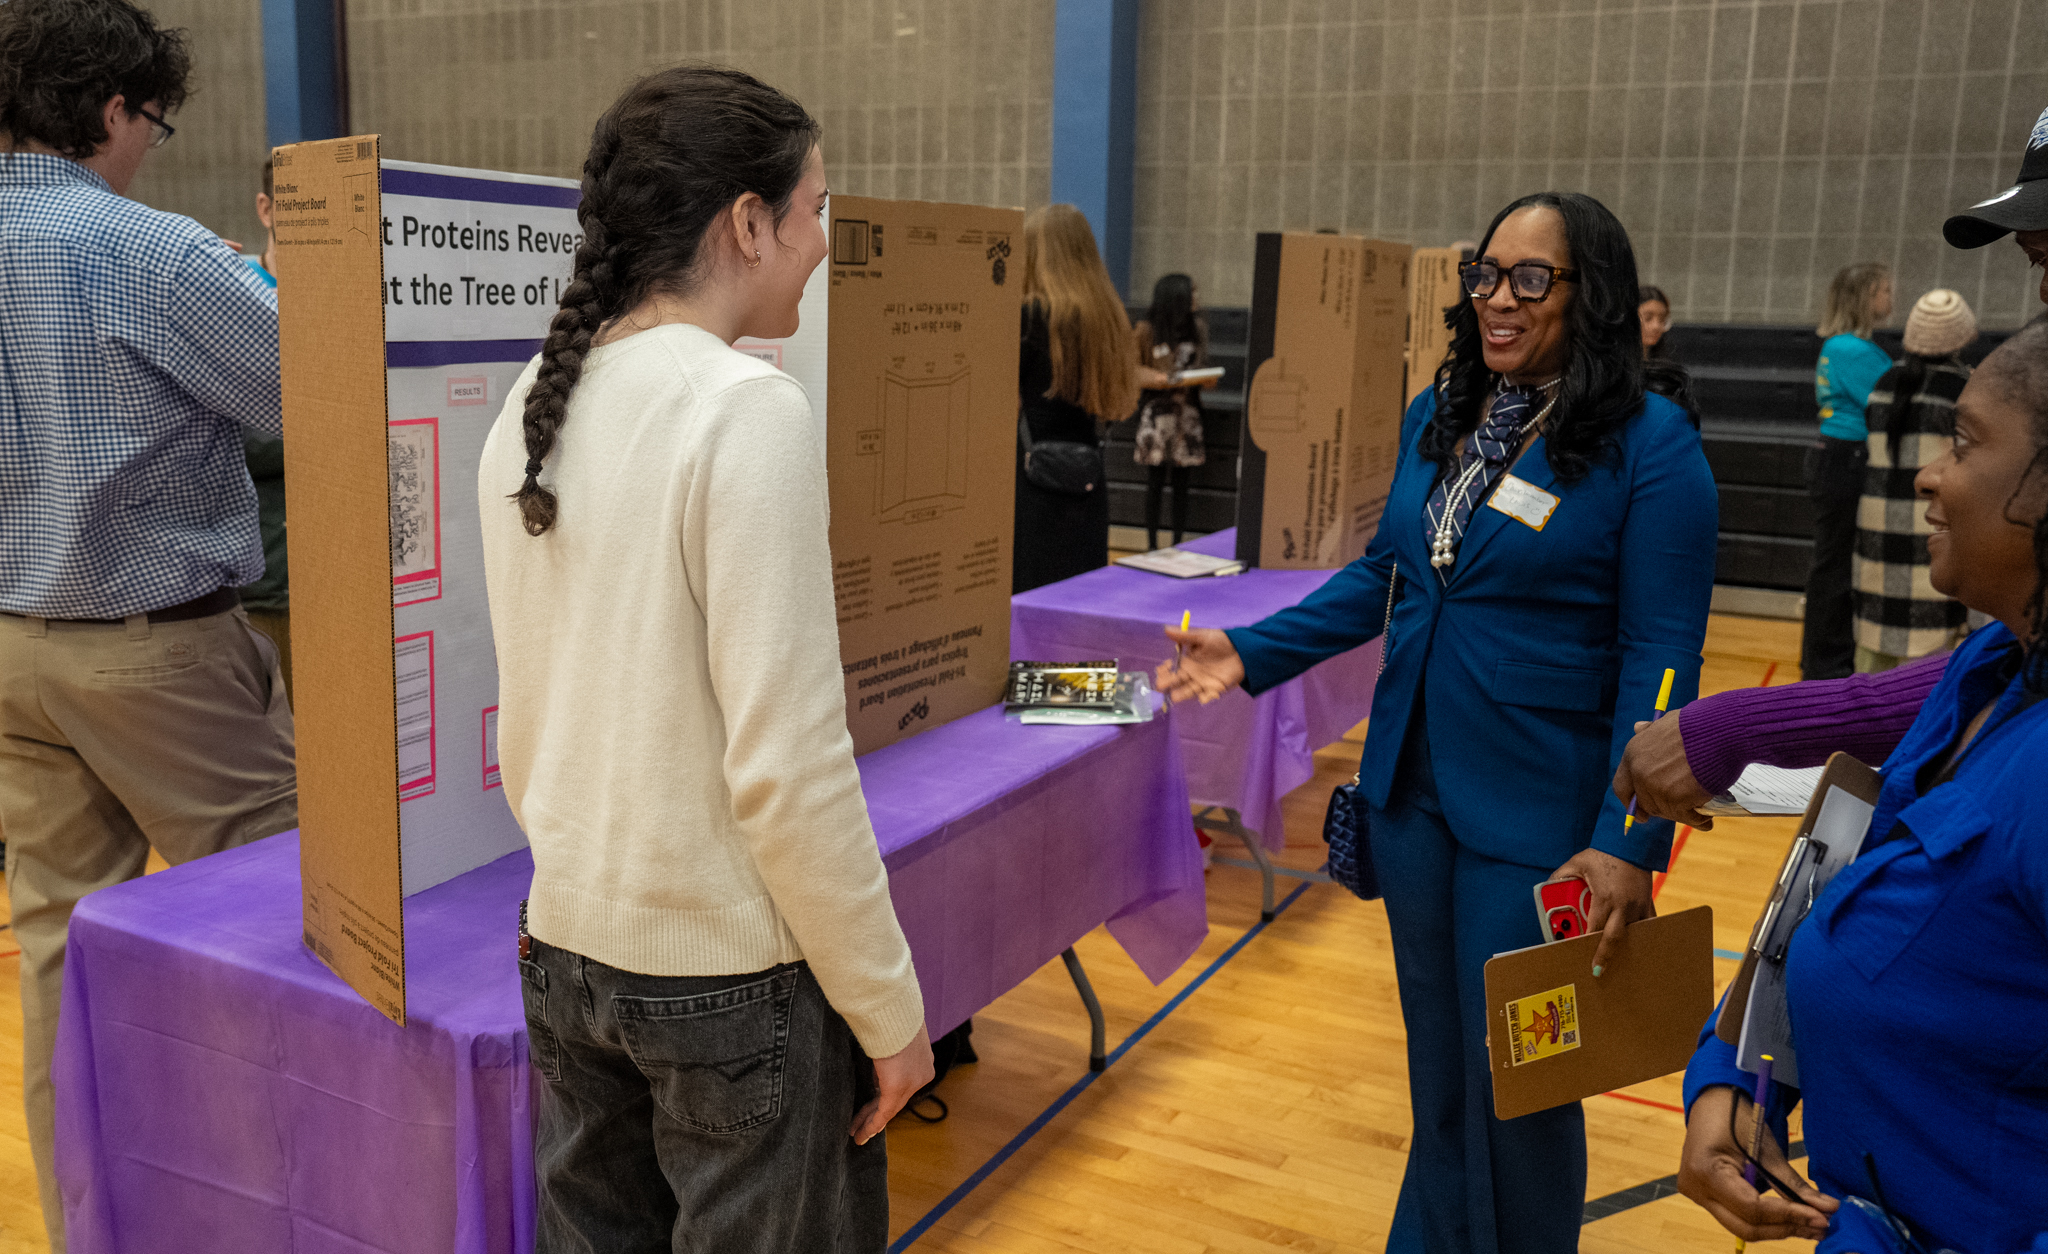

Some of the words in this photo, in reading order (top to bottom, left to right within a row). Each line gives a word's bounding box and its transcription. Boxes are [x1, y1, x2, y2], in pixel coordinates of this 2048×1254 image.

[282, 199, 292, 212] Fold
[293, 198, 310, 214] Project
[311, 196, 326, 210] Board
[402, 216, 510, 252] Proteins
[410, 274, 452, 306] the
[460, 276, 516, 306] Tree
[524, 276, 548, 306] of
[455, 387, 481, 396] RESULTS
[860, 691, 884, 712] Board
[342, 924, 357, 944] Board
[358, 940, 378, 960] Project
[378, 952, 391, 972] Fold
[391, 962, 399, 976] Tri
[1509, 1003, 1518, 1024] JONES
